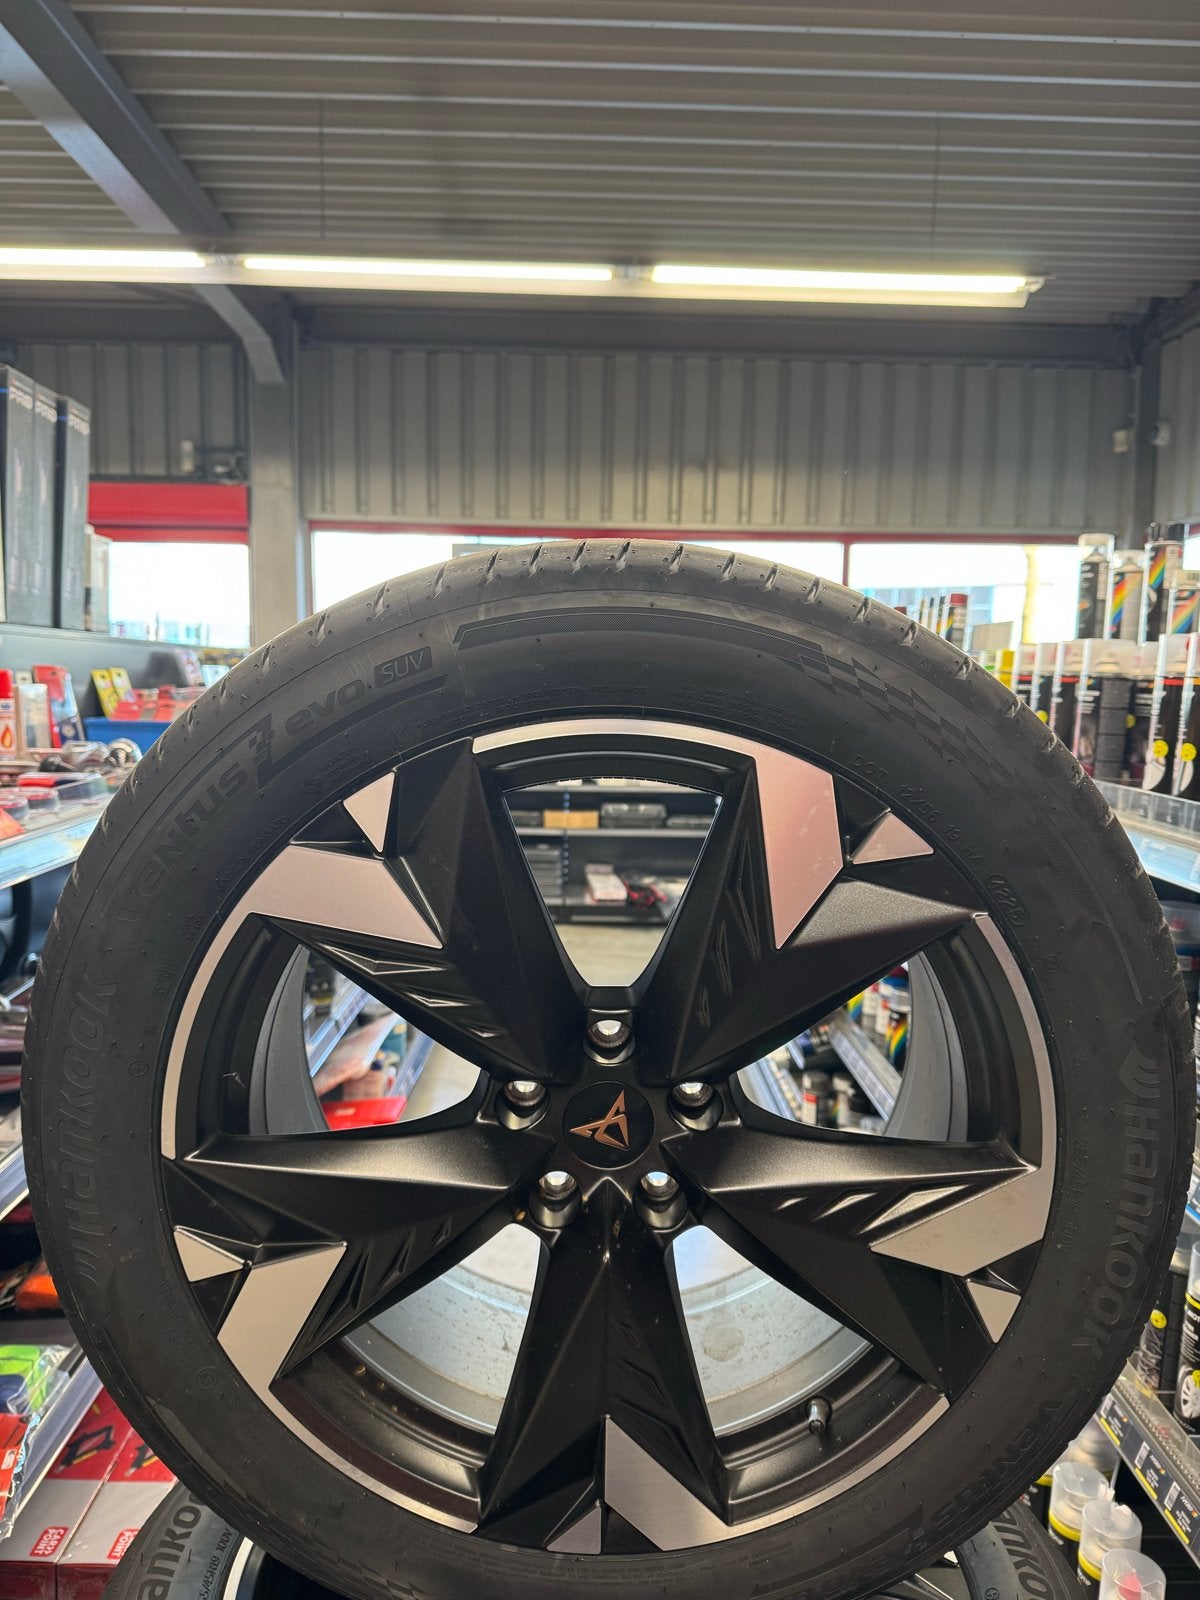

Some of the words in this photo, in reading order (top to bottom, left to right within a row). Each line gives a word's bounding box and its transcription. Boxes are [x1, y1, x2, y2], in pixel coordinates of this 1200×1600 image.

[381, 652, 425, 681] SUV
[853, 752, 888, 782] DOT
[1071, 1101, 1161, 1361] Hankook
[34, 1528, 54, 1555] POINT
